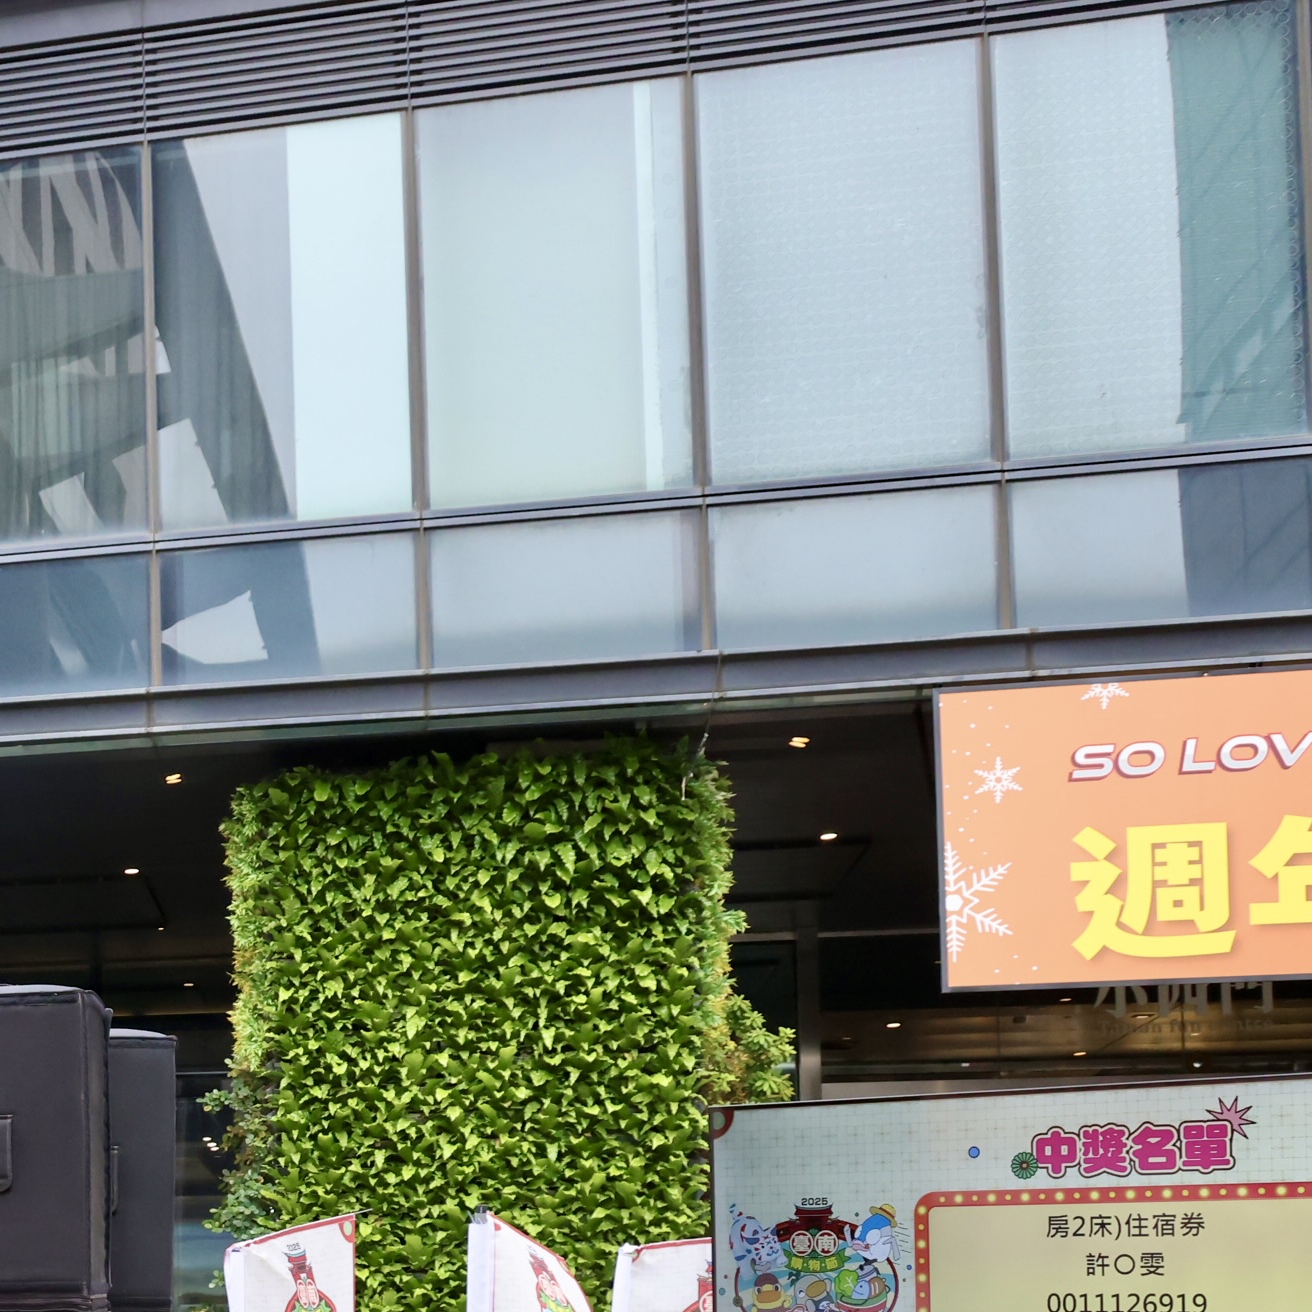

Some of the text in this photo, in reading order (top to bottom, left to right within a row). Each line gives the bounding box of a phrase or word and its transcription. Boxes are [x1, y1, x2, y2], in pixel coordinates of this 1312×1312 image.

[1068, 741, 1166, 782] SO
[1034, 1122, 1233, 1176] 中獎名單
[801, 1197, 828, 1206] 2025
[1046, 1213, 1206, 1240] 房2床)住宿券
